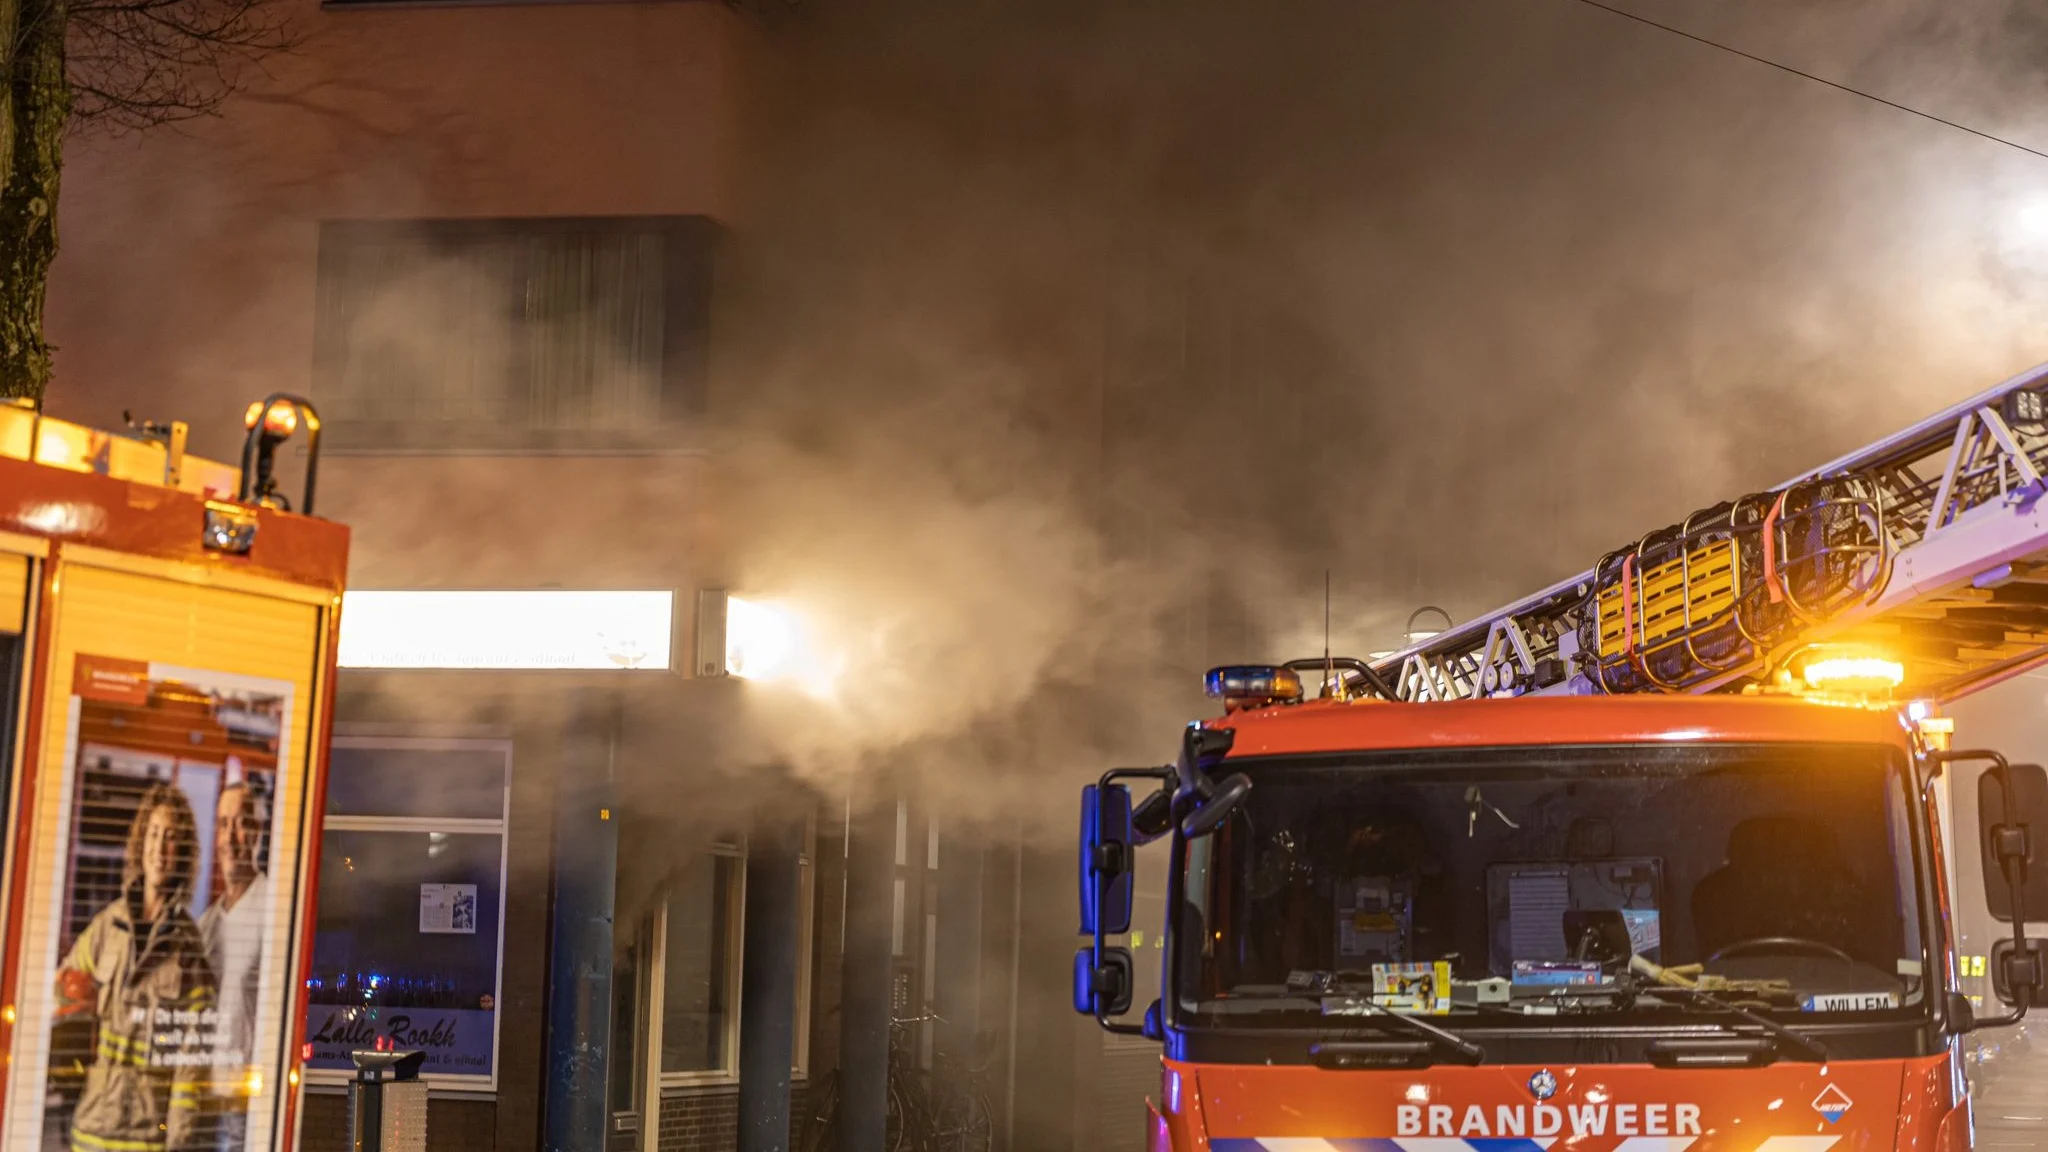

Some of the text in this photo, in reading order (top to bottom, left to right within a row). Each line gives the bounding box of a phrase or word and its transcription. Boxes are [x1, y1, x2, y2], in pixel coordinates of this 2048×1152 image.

[313, 1012, 457, 1047] Lalla Rookh
[1396, 1103, 1702, 1136] BRANDWEER
